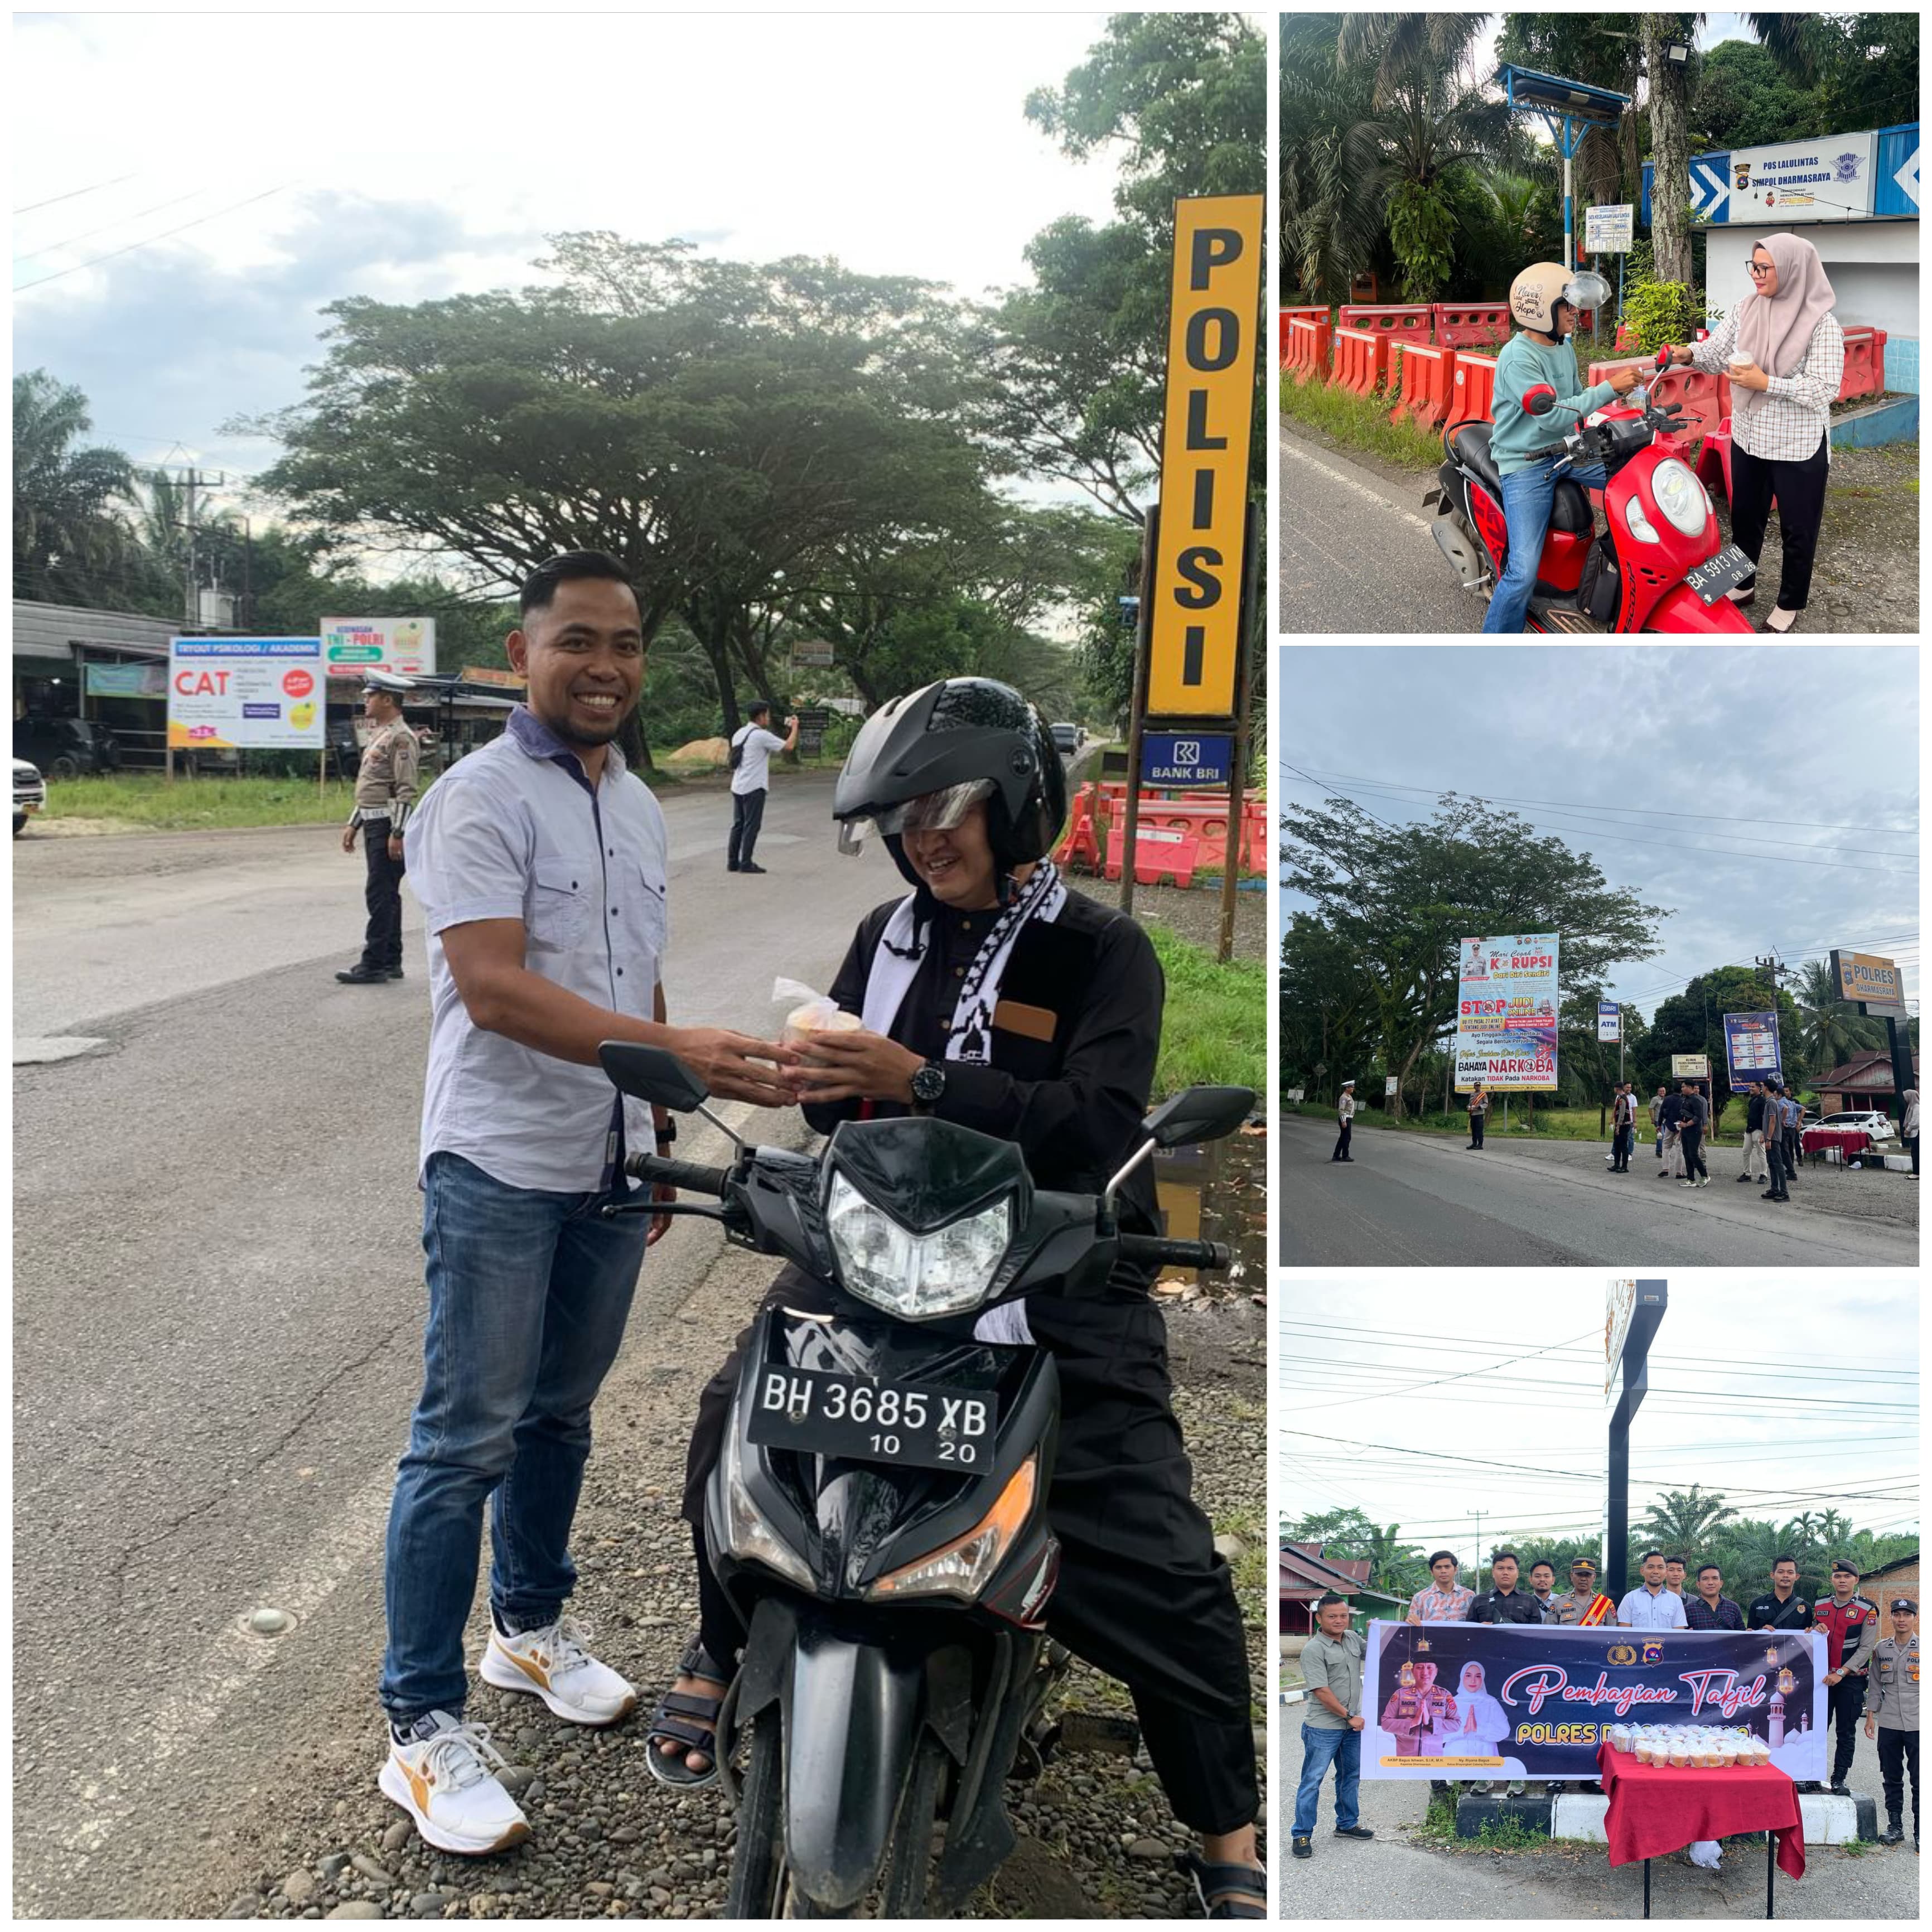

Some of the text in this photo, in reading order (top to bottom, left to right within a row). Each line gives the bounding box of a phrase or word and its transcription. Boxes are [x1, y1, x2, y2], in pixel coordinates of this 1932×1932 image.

[1764, 161, 1776, 170] POS
[1778, 157, 1819, 169] LALULINTAS
[1752, 172, 1830, 187] SIMPOL DHARMASRAYA
[1518, 286, 1539, 298] Never
[1515, 301, 1535, 316] Hope
[1173, 228, 1244, 686] POLISI
[1686, 545, 1746, 590] BA 5913 VM
[1731, 562, 1756, 581] 08 26
[175, 670, 230, 696] CAT
[1152, 767, 1219, 779] BANK BRI
[1490, 955, 1553, 970] KRUPSI
[1853, 964, 1894, 985] POLRES
[1856, 983, 1895, 996] DHARMASRAYA
[1461, 997, 1534, 1015] STOP JUDI
[1508, 1008, 1537, 1017] ONLINE
[1458, 1059, 1554, 1073] BAHAYA NARKOBA
[763, 1374, 986, 1436] BH 3685 XB
[870, 1434, 976, 1464] 10 20
[1501, 1664, 1767, 1719] Pembagian Takjil
[1516, 1723, 1597, 1746] POLRES
